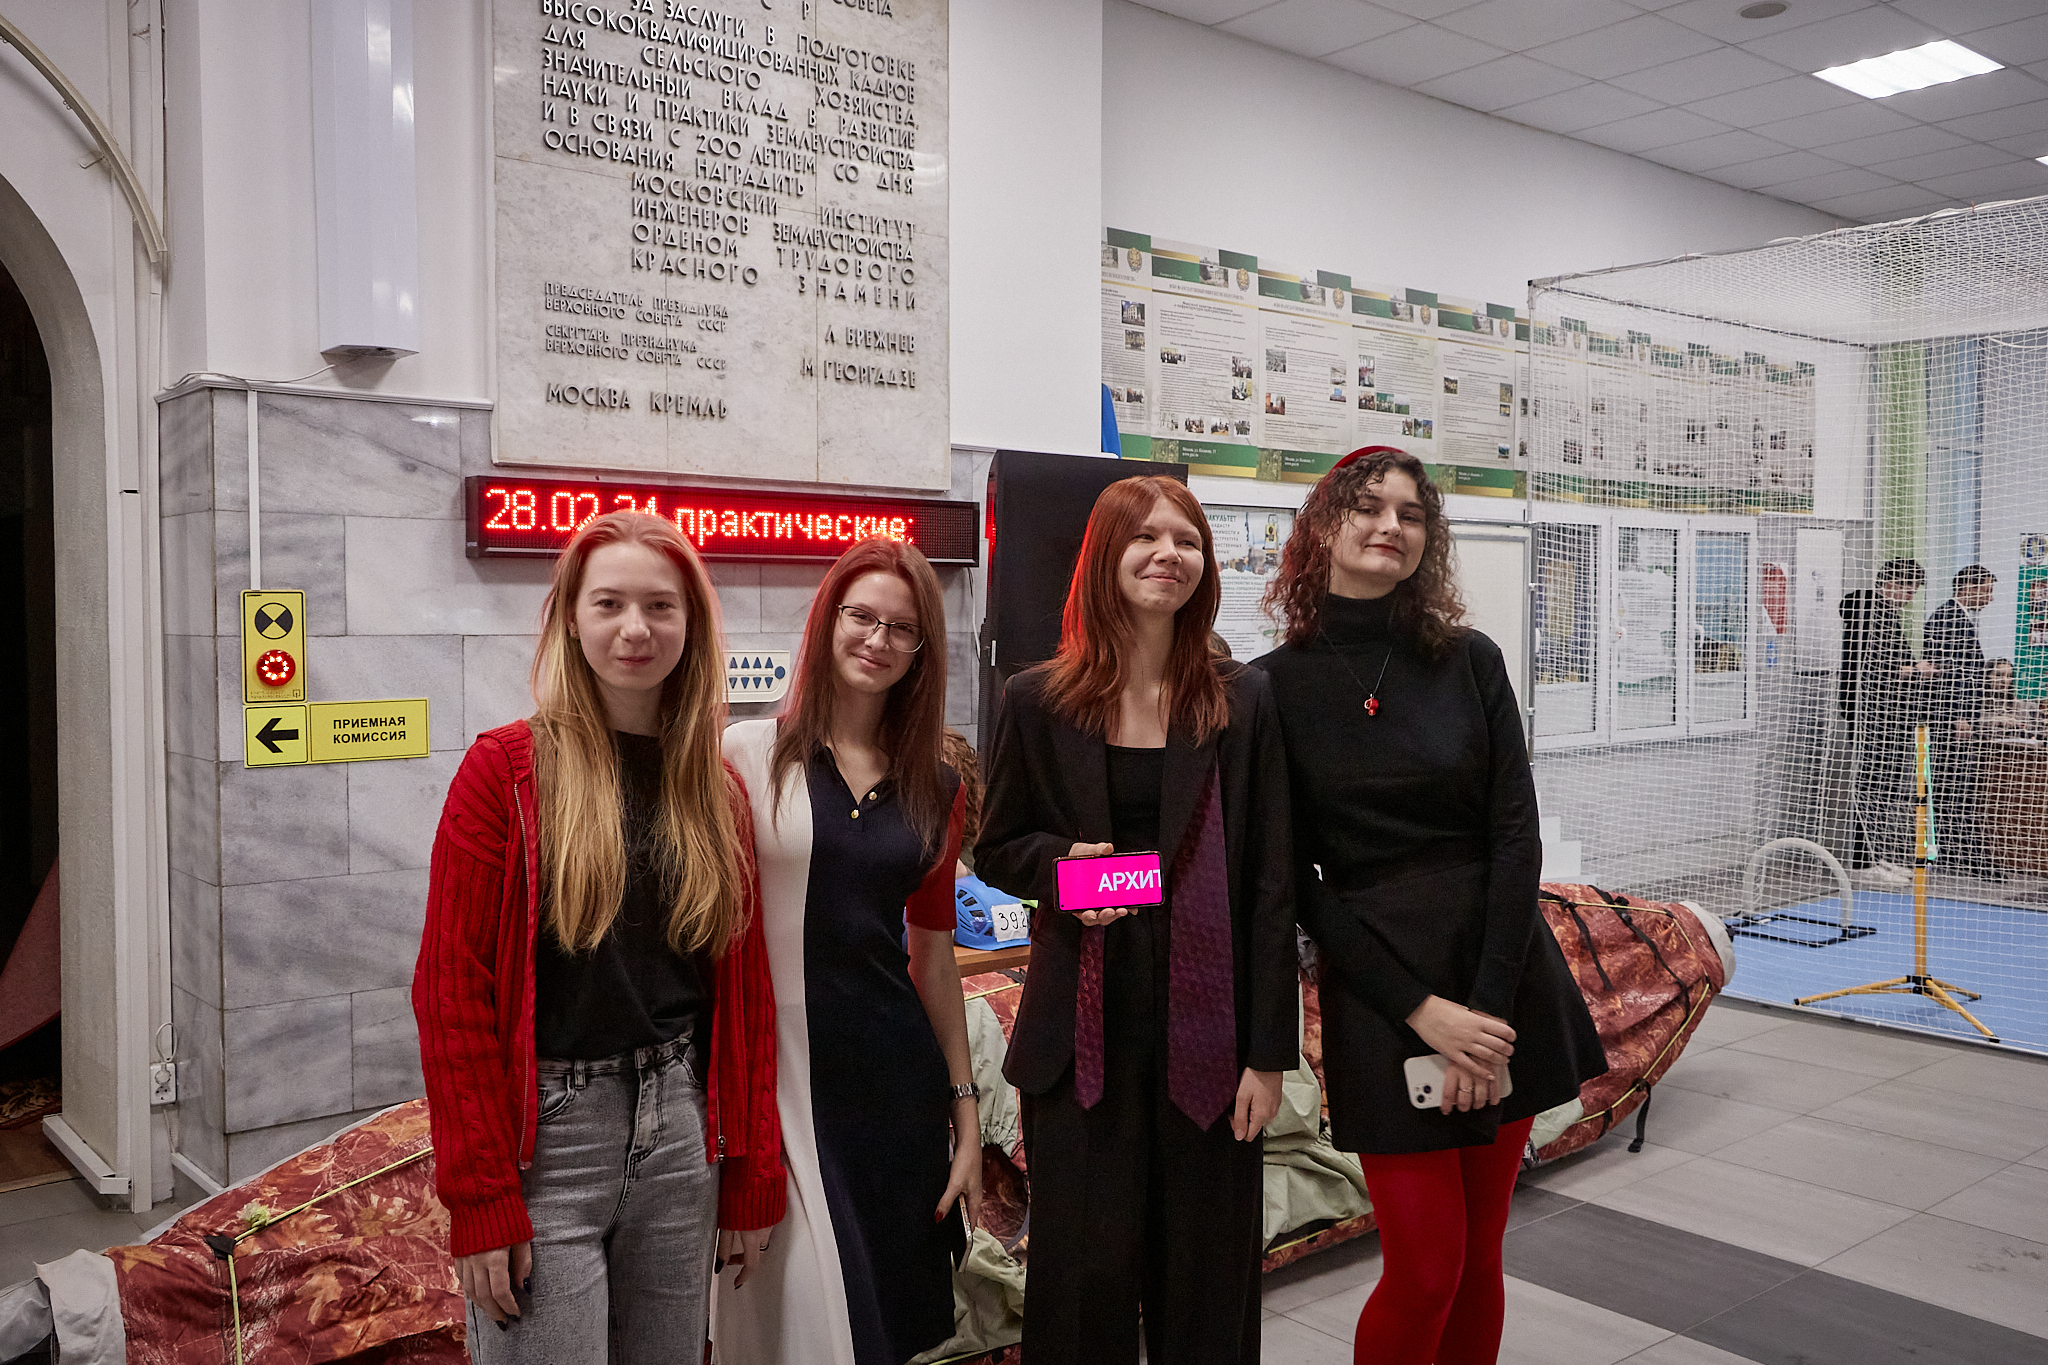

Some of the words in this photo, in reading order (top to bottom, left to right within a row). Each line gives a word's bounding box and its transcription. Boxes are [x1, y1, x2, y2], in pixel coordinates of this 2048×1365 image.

[543, 0, 839, 86] ВЫСОКОКВАЛИФИЦИРОВАННЫХ
[850, 70, 915, 104] КАДРОВ
[543, 24, 586, 49] ДЛЯ
[641, 45, 761, 90] СЕЛЬСКОГО
[665, 0, 745, 37] ЗАСЛУГИ
[766, 25, 775, 45] В
[797, 33, 915, 81] ПОДГОТОВКЕ
[543, 73, 609, 107] НАУКИ
[626, 91, 639, 113] И
[655, 97, 749, 137] ПРАКТИКИ
[722, 88, 788, 122] ВКЛАД
[808, 108, 817, 128] В
[839, 115, 915, 149] РАЗВИТИЕ
[543, 101, 556, 122] И
[570, 105, 580, 127] В
[593, 112, 654, 141] СВЯЗИ
[669, 128, 682, 148] С
[696, 133, 742, 159] 200
[751, 145, 816, 175] ЛЕТИЕМ
[834, 162, 859, 183] СО
[876, 172, 914, 195] ДНЯ
[543, 128, 675, 171] ОСНОВАНИЯ
[695, 157, 805, 197] НАГРАДИТЬ
[632, 196, 749, 236] ИНЖЕНЕРОВ
[820, 206, 915, 241] ИНСТИТУТ
[632, 222, 738, 258] ОРДЕНОМ
[776, 245, 915, 285] ТРУДОВОГО
[631, 247, 759, 286] КРАСНОГО
[798, 275, 915, 309] ЗНАМЕНИ
[545, 297, 626, 319] ВЕРХОВНОГО
[636, 308, 683, 327] СОВЕТА
[697, 319, 727, 333] СССР
[652, 296, 729, 318] ПРЕЗИДИУМА
[545, 338, 629, 361] ВЕРХОВНОГО
[636, 349, 682, 366] СОВЕТА
[697, 356, 727, 371] СССР
[621, 332, 698, 354] ПРЕЗИДИУМА
[845, 325, 916, 353] БРЕЖНЕВ
[801, 357, 814, 377] М
[823, 360, 916, 388] ГЕОРГАДЗЕ
[546, 381, 631, 410] МОСКВА
[650, 390, 728, 420] КРЕМЛЬ
[333, 716, 406, 729] ПРИЕМНАЯ
[333, 730, 407, 744] КОМИССИЯ
